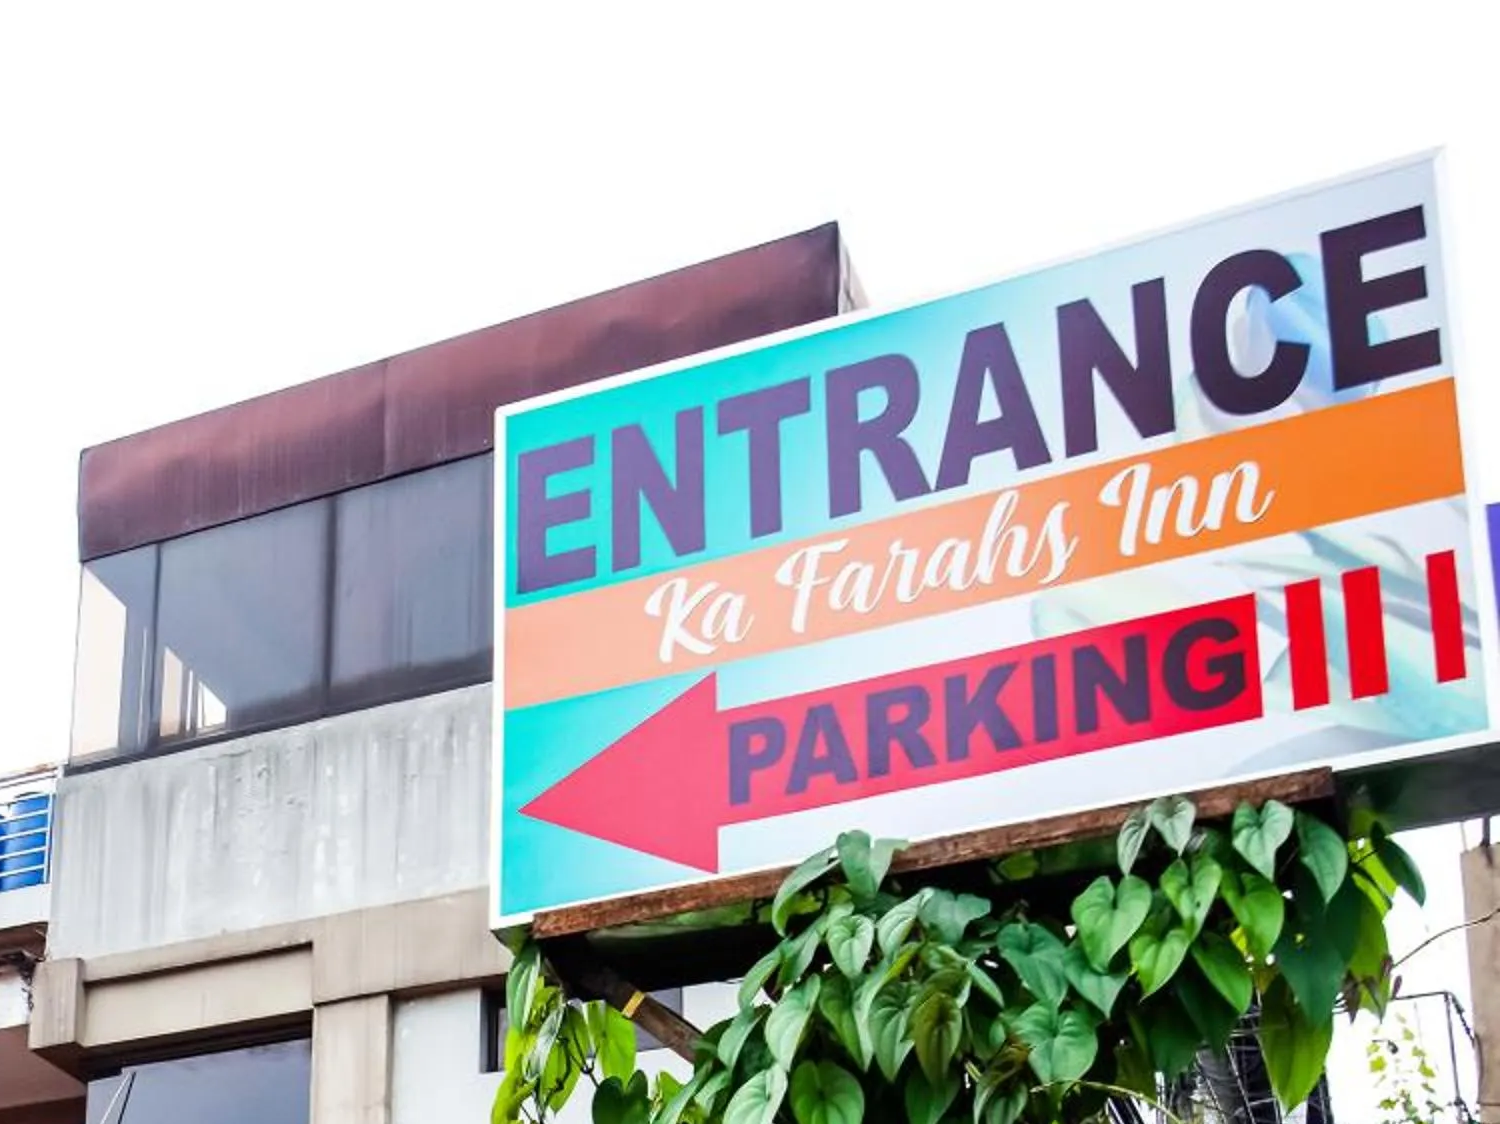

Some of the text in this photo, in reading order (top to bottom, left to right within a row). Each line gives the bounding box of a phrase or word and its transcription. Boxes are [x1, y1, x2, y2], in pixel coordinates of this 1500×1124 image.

[516, 204, 1443, 595] ENTRANCE
[645, 461, 1274, 663] Ka Farahs Inn
[728, 617, 1248, 806] PARKING
